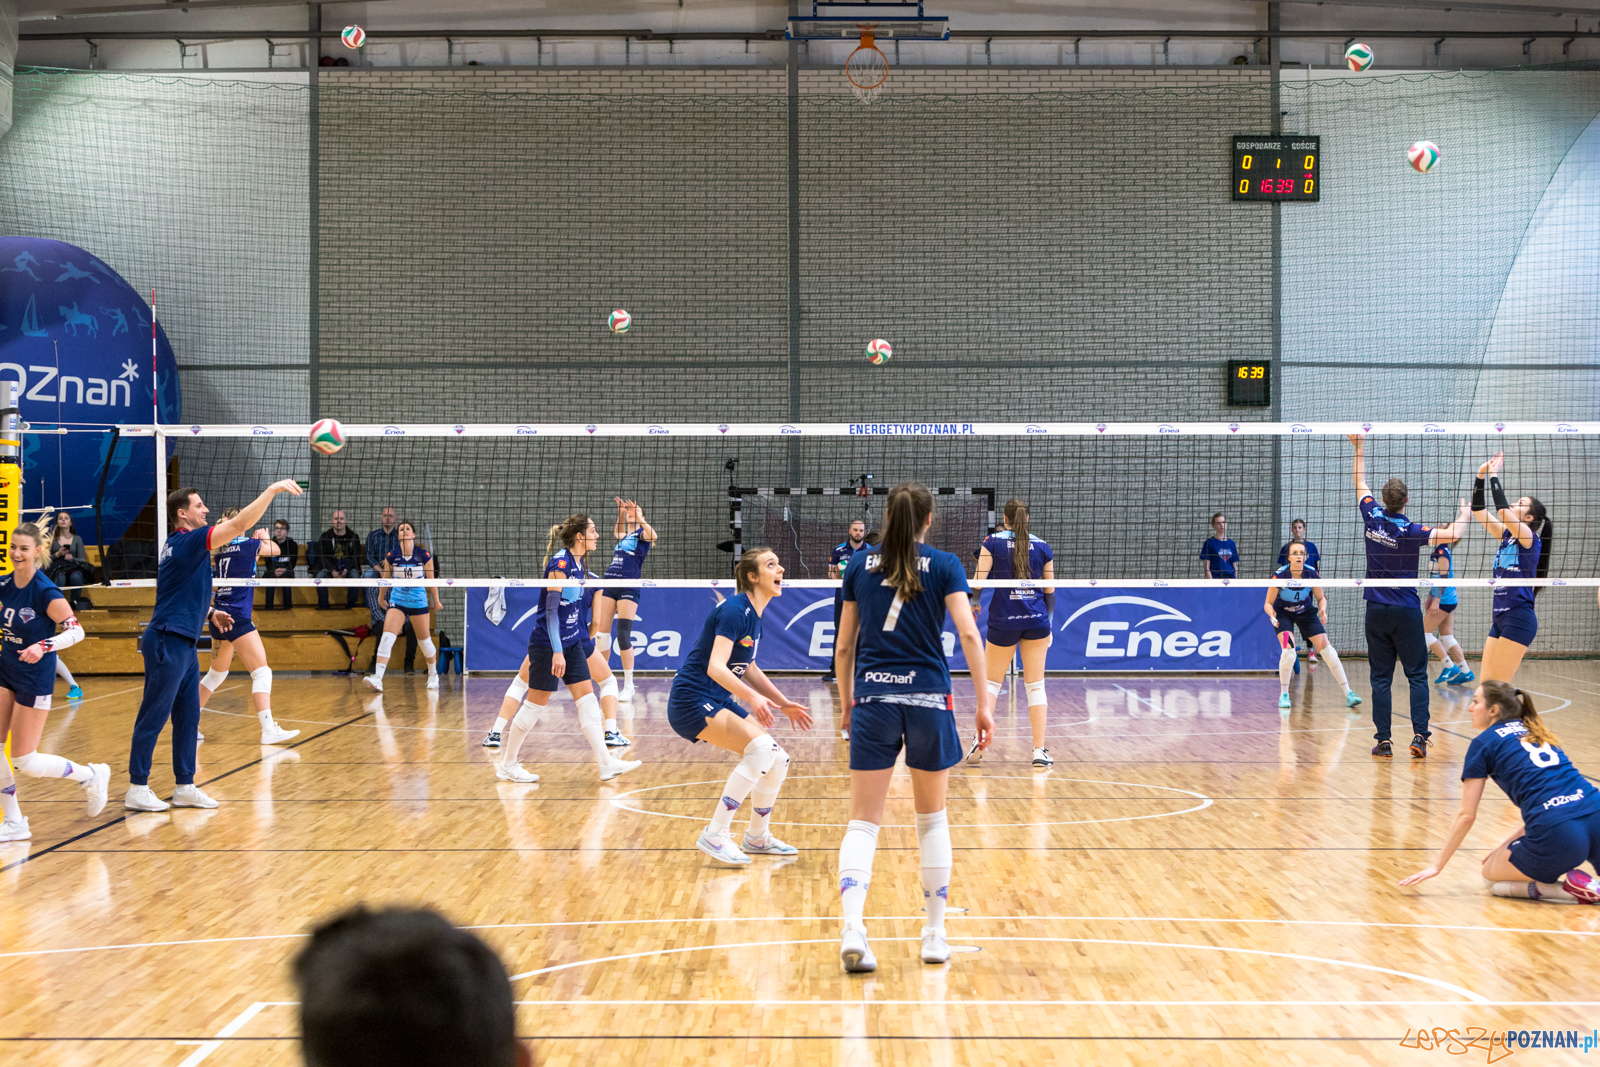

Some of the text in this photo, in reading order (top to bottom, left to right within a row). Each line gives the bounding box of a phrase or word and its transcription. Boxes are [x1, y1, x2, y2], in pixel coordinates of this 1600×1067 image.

[1236, 142, 1281, 150] GOSPODARZE
[1242, 155, 1252, 169] 0
[1304, 155, 1314, 169] 0
[1239, 179, 1249, 193] 0
[1304, 179, 1314, 193] 0
[849, 424, 975, 435] ENERGETYKPOZNAN.PL
[218, 557, 232, 579] 17
[1293, 591, 1300, 601] 4
[880, 579, 907, 631] 7
[3, 607, 16, 628] 9
[4, 635, 23, 645] nea
[612, 630, 682, 657] ea
[1085, 621, 1232, 657] Enea
[1520, 737, 1560, 768] 8
